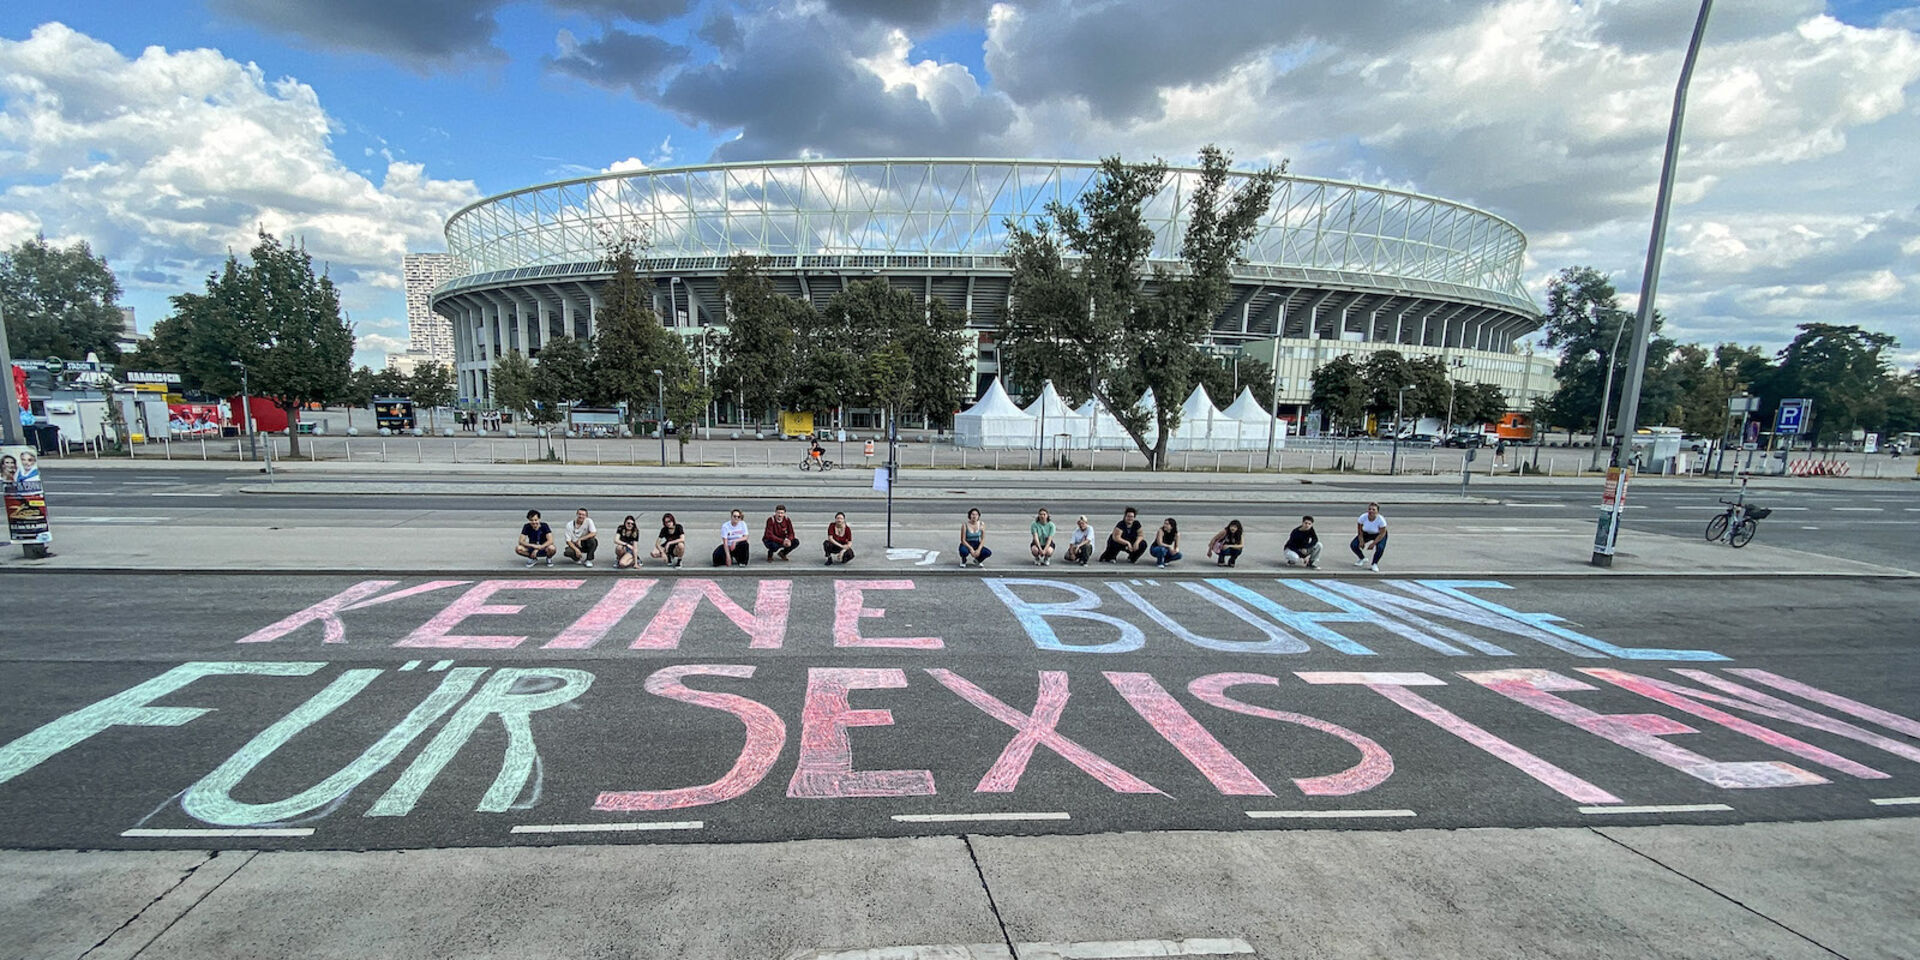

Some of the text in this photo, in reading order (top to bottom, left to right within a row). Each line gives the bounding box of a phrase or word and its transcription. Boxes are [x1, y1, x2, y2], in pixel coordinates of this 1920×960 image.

[237, 577, 1734, 661] KEINE BÜHNE
[0, 660, 1920, 828] FÜR SEXISTEN
